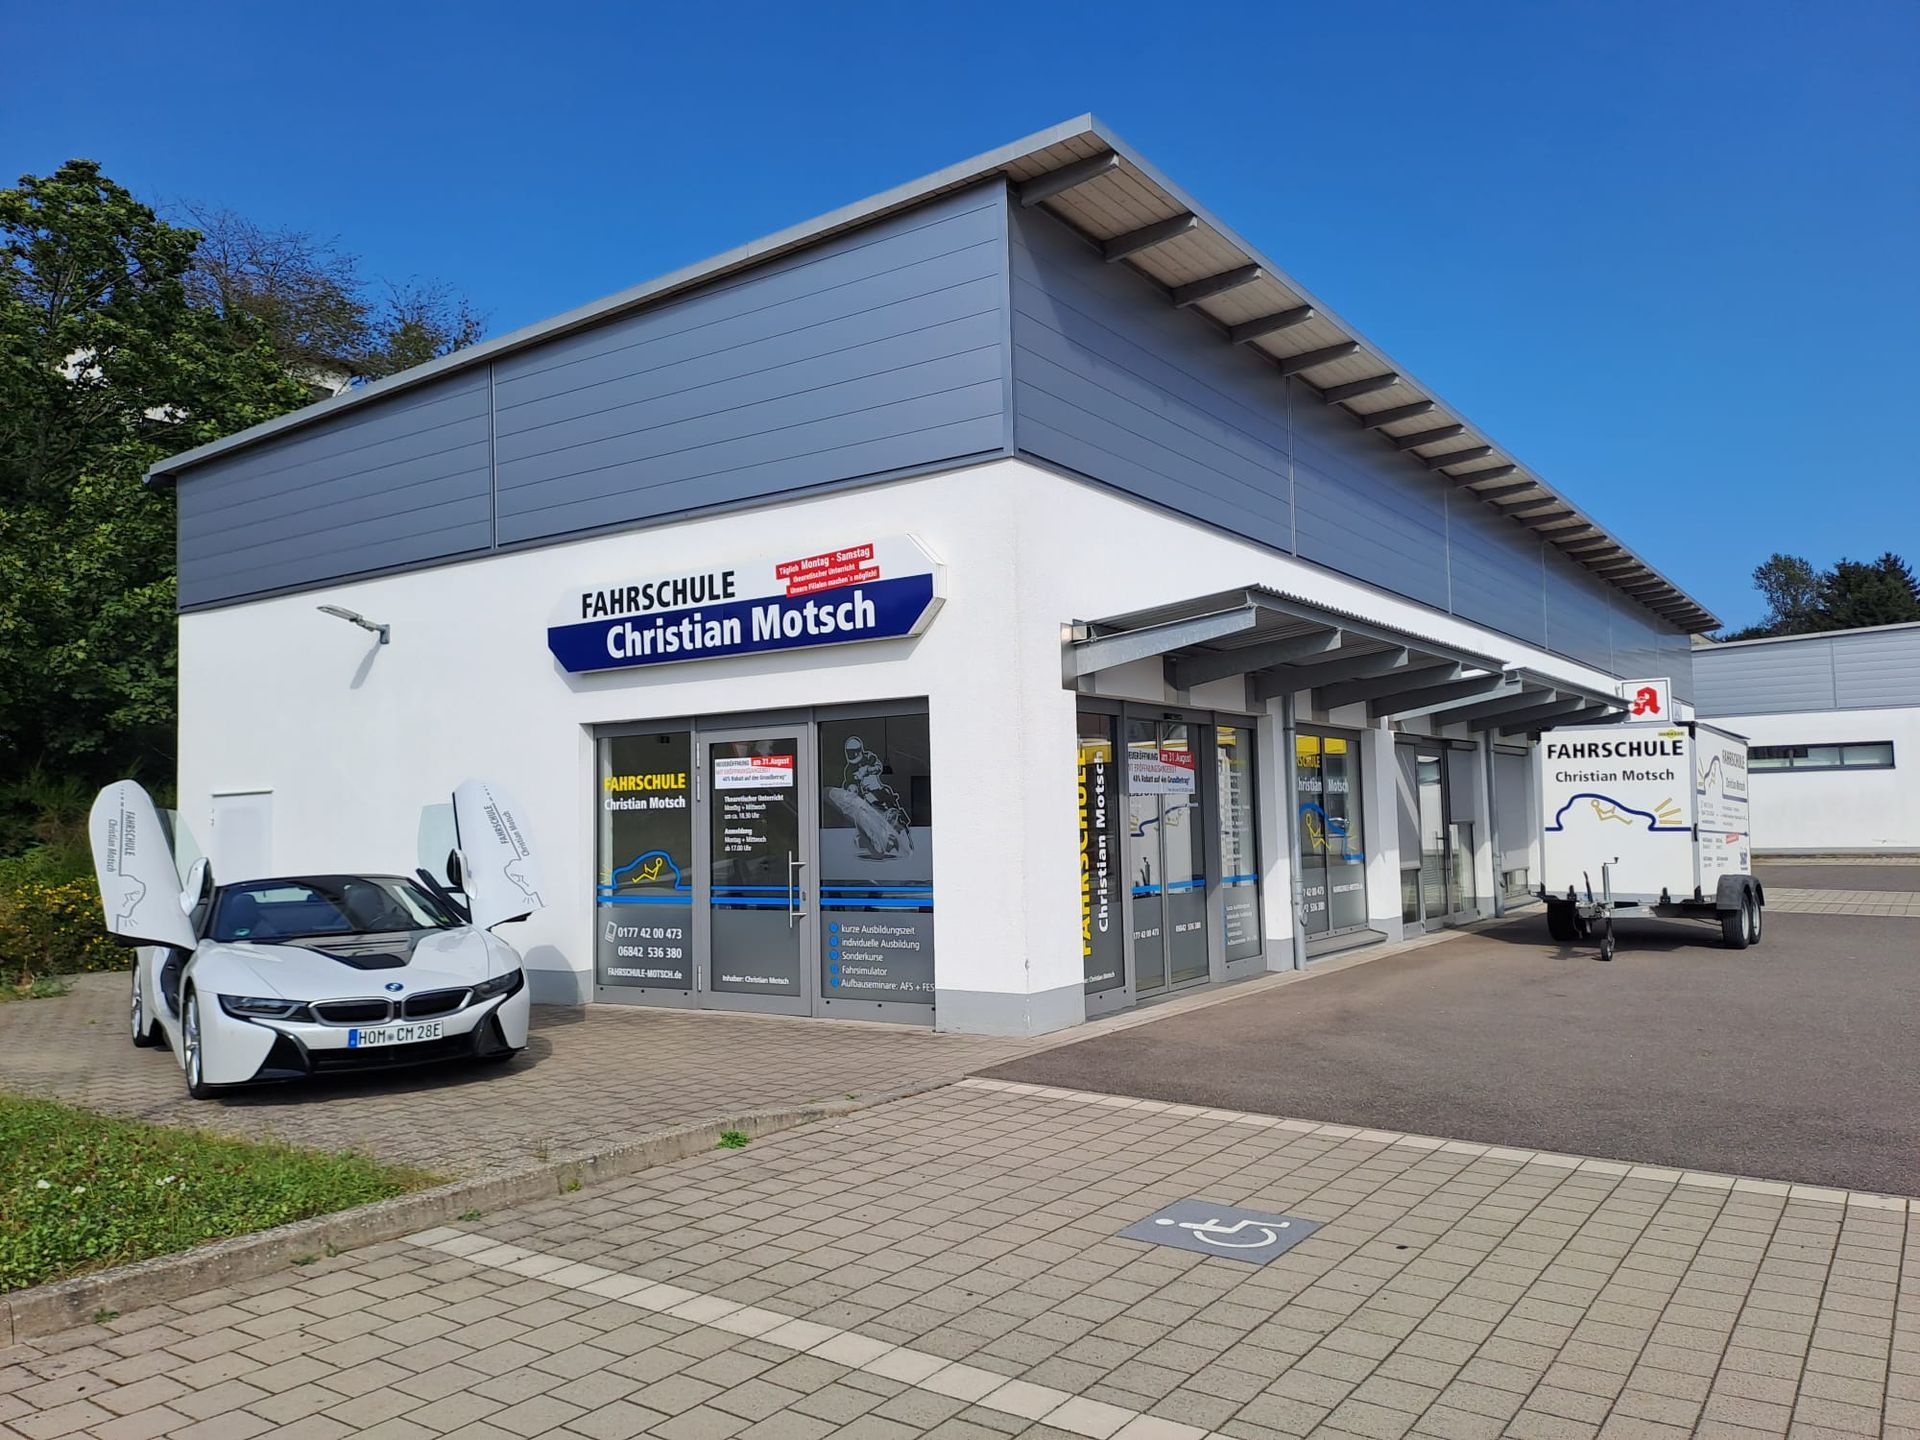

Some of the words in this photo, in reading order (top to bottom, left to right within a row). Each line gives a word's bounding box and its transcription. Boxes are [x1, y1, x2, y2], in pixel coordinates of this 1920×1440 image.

[801, 557, 829, 569] Montag
[836, 547, 870, 562] Samstag
[828, 564, 855, 575] Unterricht
[582, 570, 735, 618] FAHRSCHULE
[607, 613, 741, 659] Christian
[752, 590, 875, 641] Motsch
[1547, 740, 1683, 759] FAHRSCHULE
[604, 772, 686, 791] FAHRSCHULE
[1298, 777, 1322, 792] hristian
[1328, 777, 1348, 792] Motsch
[1555, 770, 1617, 783] Christian
[1623, 768, 1674, 781] Motsch
[1094, 751, 1106, 829] Motsch
[604, 797, 647, 810] Christian
[649, 795, 686, 809] Motsch
[484, 805, 509, 844] FAHRSCHULE
[503, 811, 517, 831] Motsch
[108, 819, 118, 847] Christian
[124, 811, 136, 856] FAHRSCHULE
[514, 831, 530, 856] Christian
[107, 848, 117, 872] Motsch
[1097, 835, 1108, 932] Christian
[617, 927, 638, 938] 0177
[640, 928, 651, 938] 42
[652, 928, 664, 939] 00
[665, 928, 682, 939] 473
[842, 924, 859, 933] kurze
[861, 924, 915, 936] Ausbildungszeit
[617, 946, 643, 957] 06842
[647, 947, 664, 958] 536
[665, 947, 682, 958] 380
[842, 938, 879, 948] individuelle
[881, 939, 920, 951] Ausbildung
[842, 951, 883, 961] Sonderkurse
[608, 967, 682, 979] FAHRSCHULE-MOTSCH.de
[745, 975, 768, 983] Christian
[842, 965, 887, 976] Fahrsimulator
[841, 978, 898, 990] Aufbauseminare:
[900, 982, 913, 991] AFS
[922, 983, 935, 992] FES
[359, 1030, 386, 1044] HOM
[397, 1027, 413, 1041] CM
[418, 1023, 440, 1039] 28E
